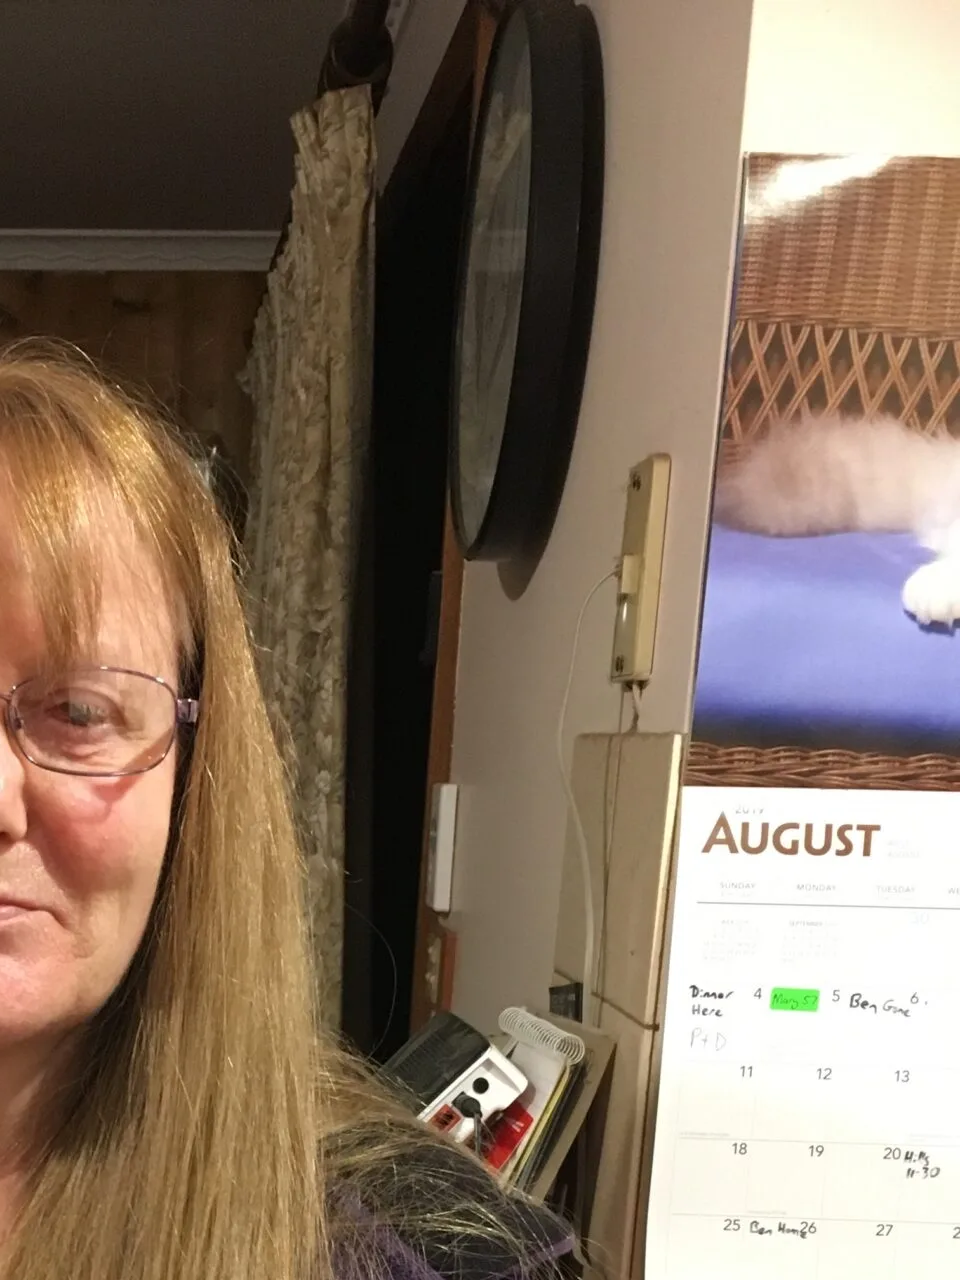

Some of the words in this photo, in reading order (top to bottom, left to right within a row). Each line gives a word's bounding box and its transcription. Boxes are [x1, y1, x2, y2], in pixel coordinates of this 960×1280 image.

[701, 811, 881, 857] AUGUST
[720, 881, 756, 890] SUNDAY
[797, 883, 836, 892] MONDAY
[876, 885, 916, 894] TUESDAY
[753, 987, 763, 1000] 4
[831, 989, 841, 1002] 5
[691, 1003, 724, 1018] Here
[849, 993, 878, 1014] Ben
[740, 1065, 754, 1078] 11
[815, 1067, 833, 1081] 12
[895, 1070, 911, 1083] 13
[732, 1142, 748, 1155] 18
[808, 1144, 825, 1158] 19
[883, 1146, 902, 1160] 20
[723, 1218, 741, 1232] 25
[800, 1220, 818, 1234] 26
[875, 1223, 894, 1237] 27
